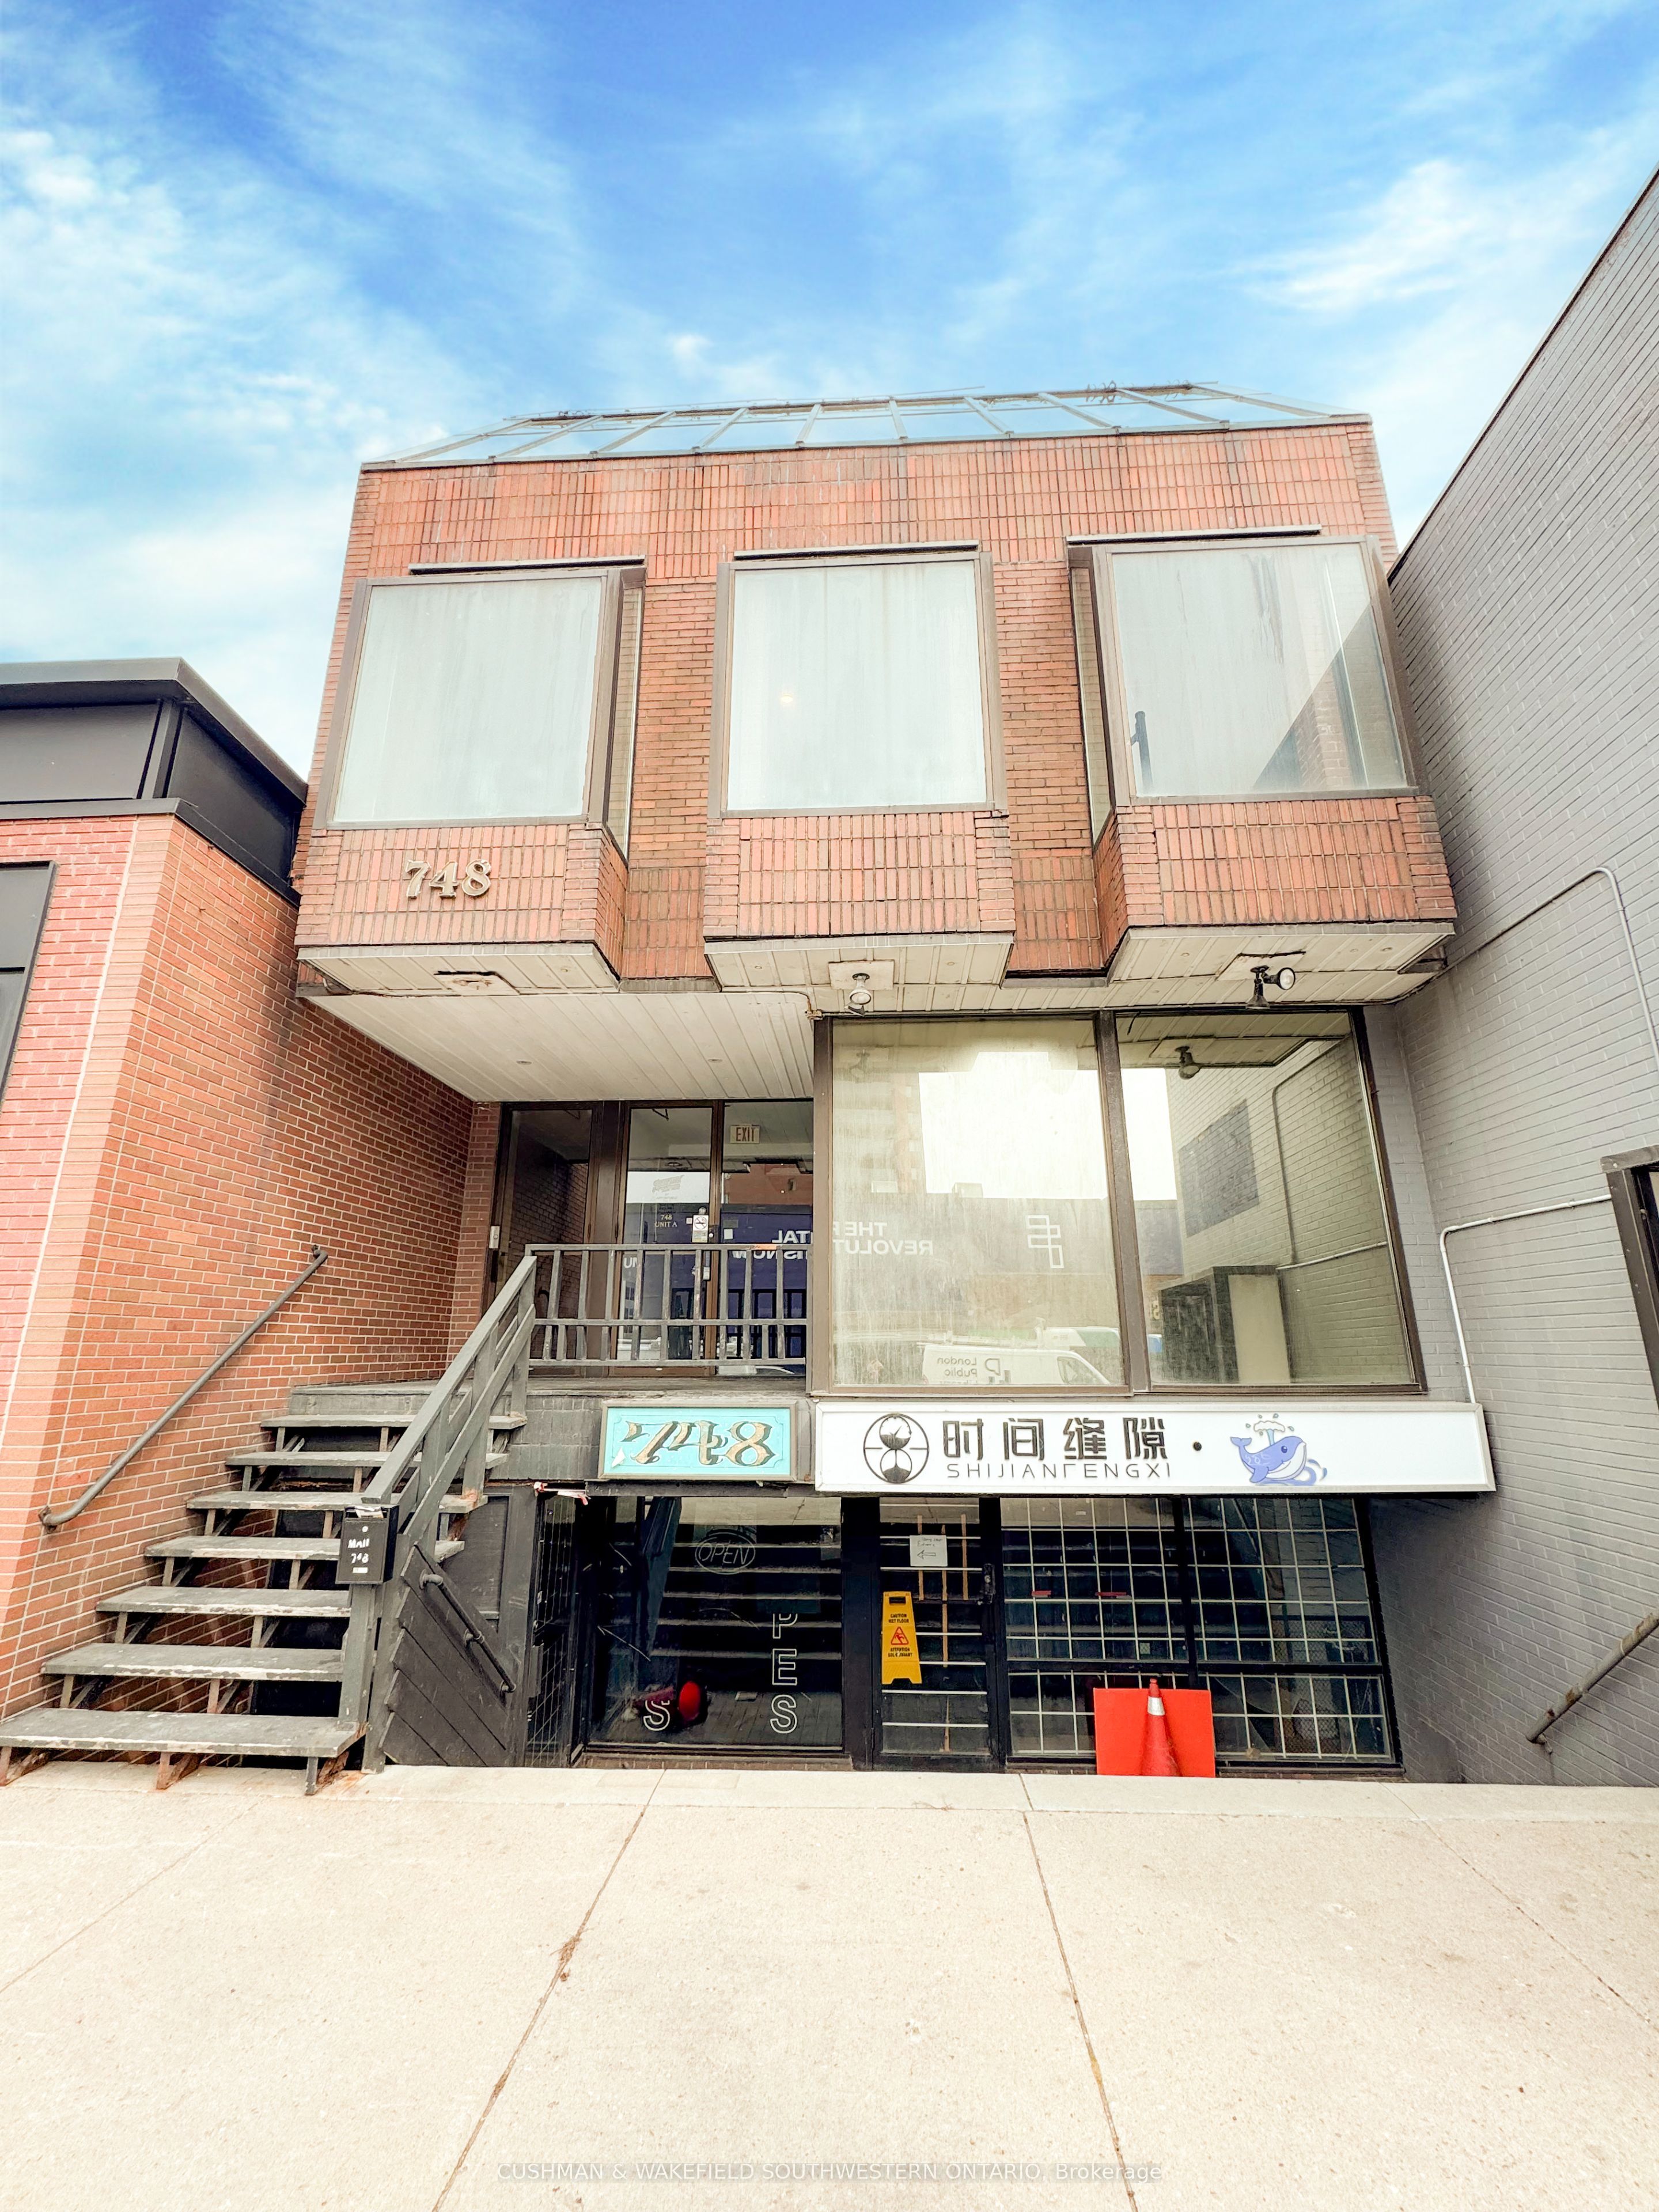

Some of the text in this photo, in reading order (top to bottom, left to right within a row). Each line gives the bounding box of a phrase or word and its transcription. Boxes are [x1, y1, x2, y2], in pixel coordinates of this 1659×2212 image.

[405, 858, 491, 899] 748
[736, 1127, 756, 1142] EXIT
[620, 1421, 776, 1467] 748
[943, 1417, 1168, 1461] 时间缝隙
[699, 1539, 749, 1565] OPEN
